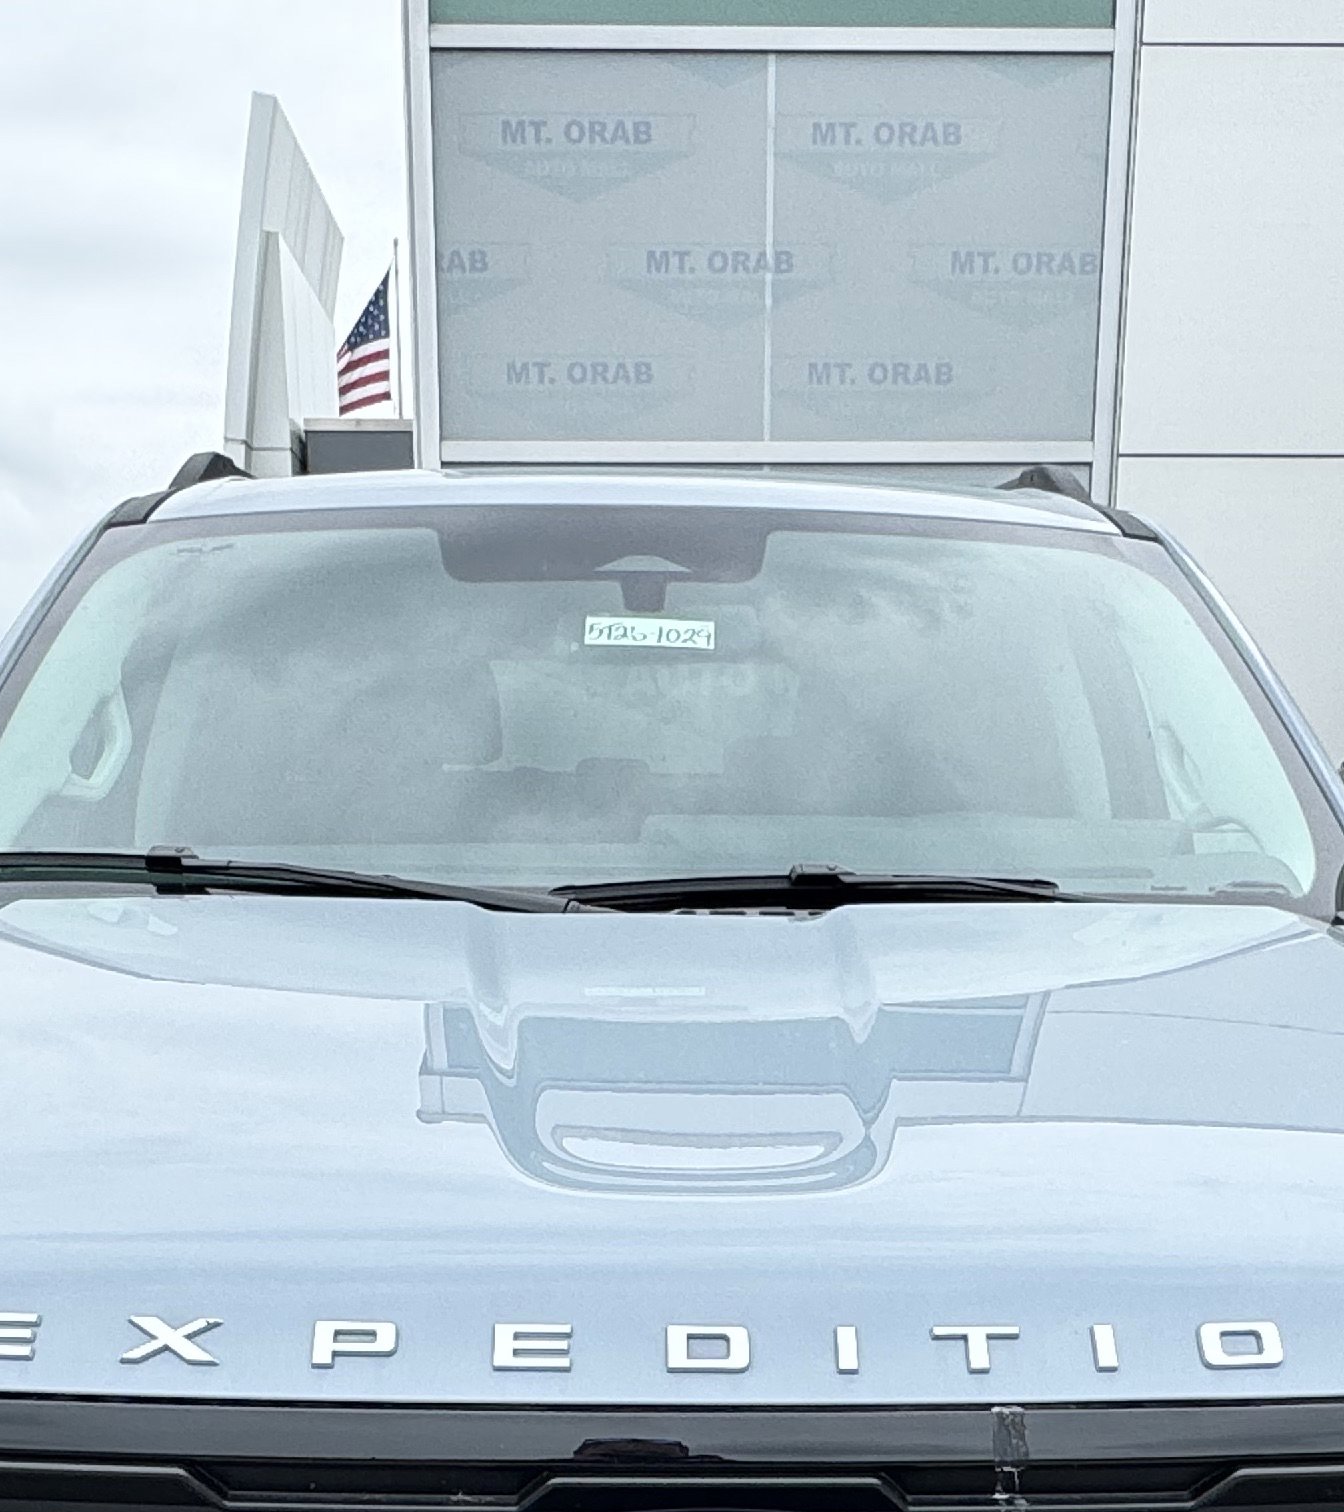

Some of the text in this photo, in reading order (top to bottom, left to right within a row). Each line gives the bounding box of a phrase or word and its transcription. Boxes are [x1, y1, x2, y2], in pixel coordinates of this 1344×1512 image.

[500, 119, 652, 145] MT. ORAB
[811, 121, 962, 146] MT. ORAB
[645, 250, 794, 274] MT. ORAB
[950, 250, 1098, 275] MT. ORAB
[506, 360, 654, 385] MT. ORAB
[807, 361, 954, 386] MT. ORAB
